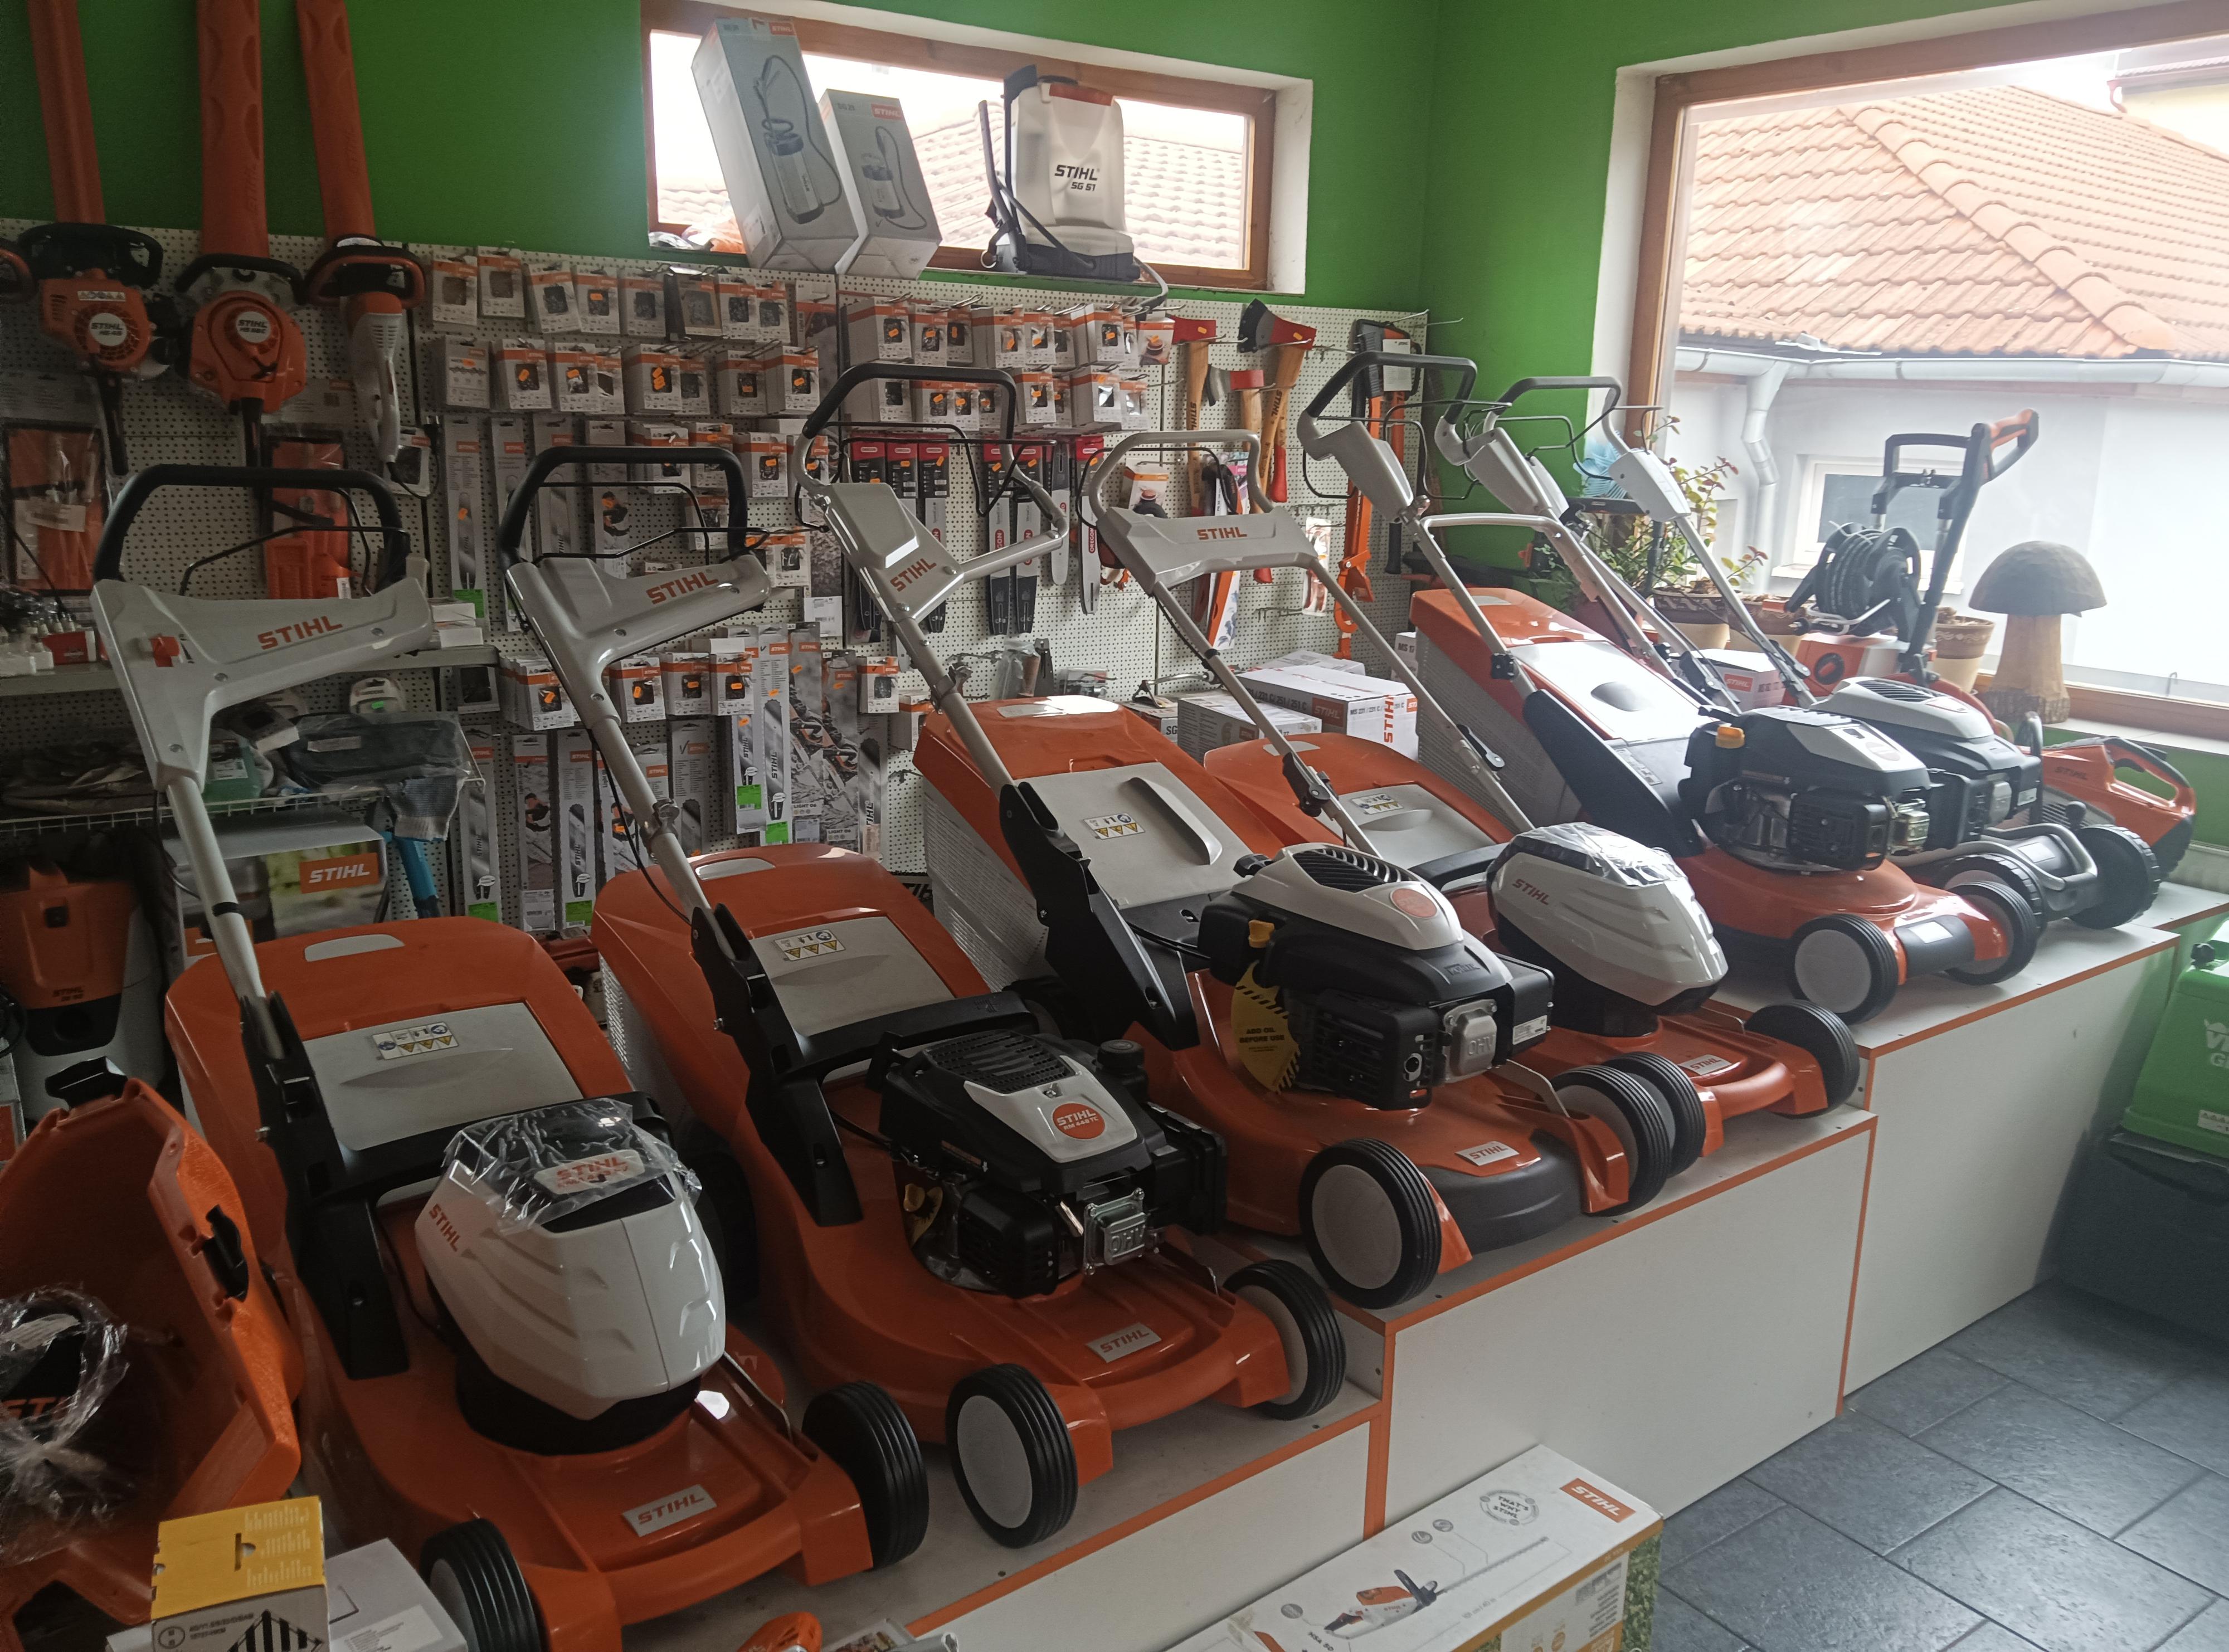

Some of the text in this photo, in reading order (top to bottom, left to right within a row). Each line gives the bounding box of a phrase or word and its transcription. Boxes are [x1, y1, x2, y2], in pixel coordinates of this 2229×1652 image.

[874, 108, 902, 118] STIHL
[1054, 164, 1097, 181] STIHL
[1070, 182, 1083, 190] SG
[239, 320, 267, 328] STIHL
[1271, 389, 1282, 416] STIHL
[1197, 527, 1247, 540] STIHL
[890, 558, 936, 592] STIHL
[646, 572, 718, 605] STIHL
[257, 616, 342, 650] STIHL
[1398, 643, 1408, 652] MS
[1726, 679, 1749, 688] STIHL
[1276, 696, 1286, 706] 251
[1291, 700, 1300, 709] 251
[1302, 702, 1307, 710] C
[1315, 705, 1340, 719] STIHL
[1166, 725, 1177, 735] SG
[2055, 766, 2087, 780] STIHL
[309, 863, 369, 884] STIHL
[1512, 879, 1550, 905] STIHL
[1468, 1035, 1496, 1055] OHV
[1690, 1058, 1722, 1070] STIHL
[1057, 1109, 1096, 1125] STIHL
[1469, 1143, 1509, 1161] STIHL
[557, 1157, 628, 1181] STIHL
[429, 1204, 462, 1252] STIHL
[1112, 1225, 1146, 1251] OHV
[1099, 1327, 1150, 1354] STIHL
[637, 1493, 705, 1524] STIHL
[1498, 1495, 1529, 1511] THAT'S
[1500, 1502, 1521, 1512] WHY
[1571, 1486, 1620, 1516] STIHL
[1493, 1505, 1517, 1519] STIHL
[1308, 1632, 1334, 1651] HSA 50
